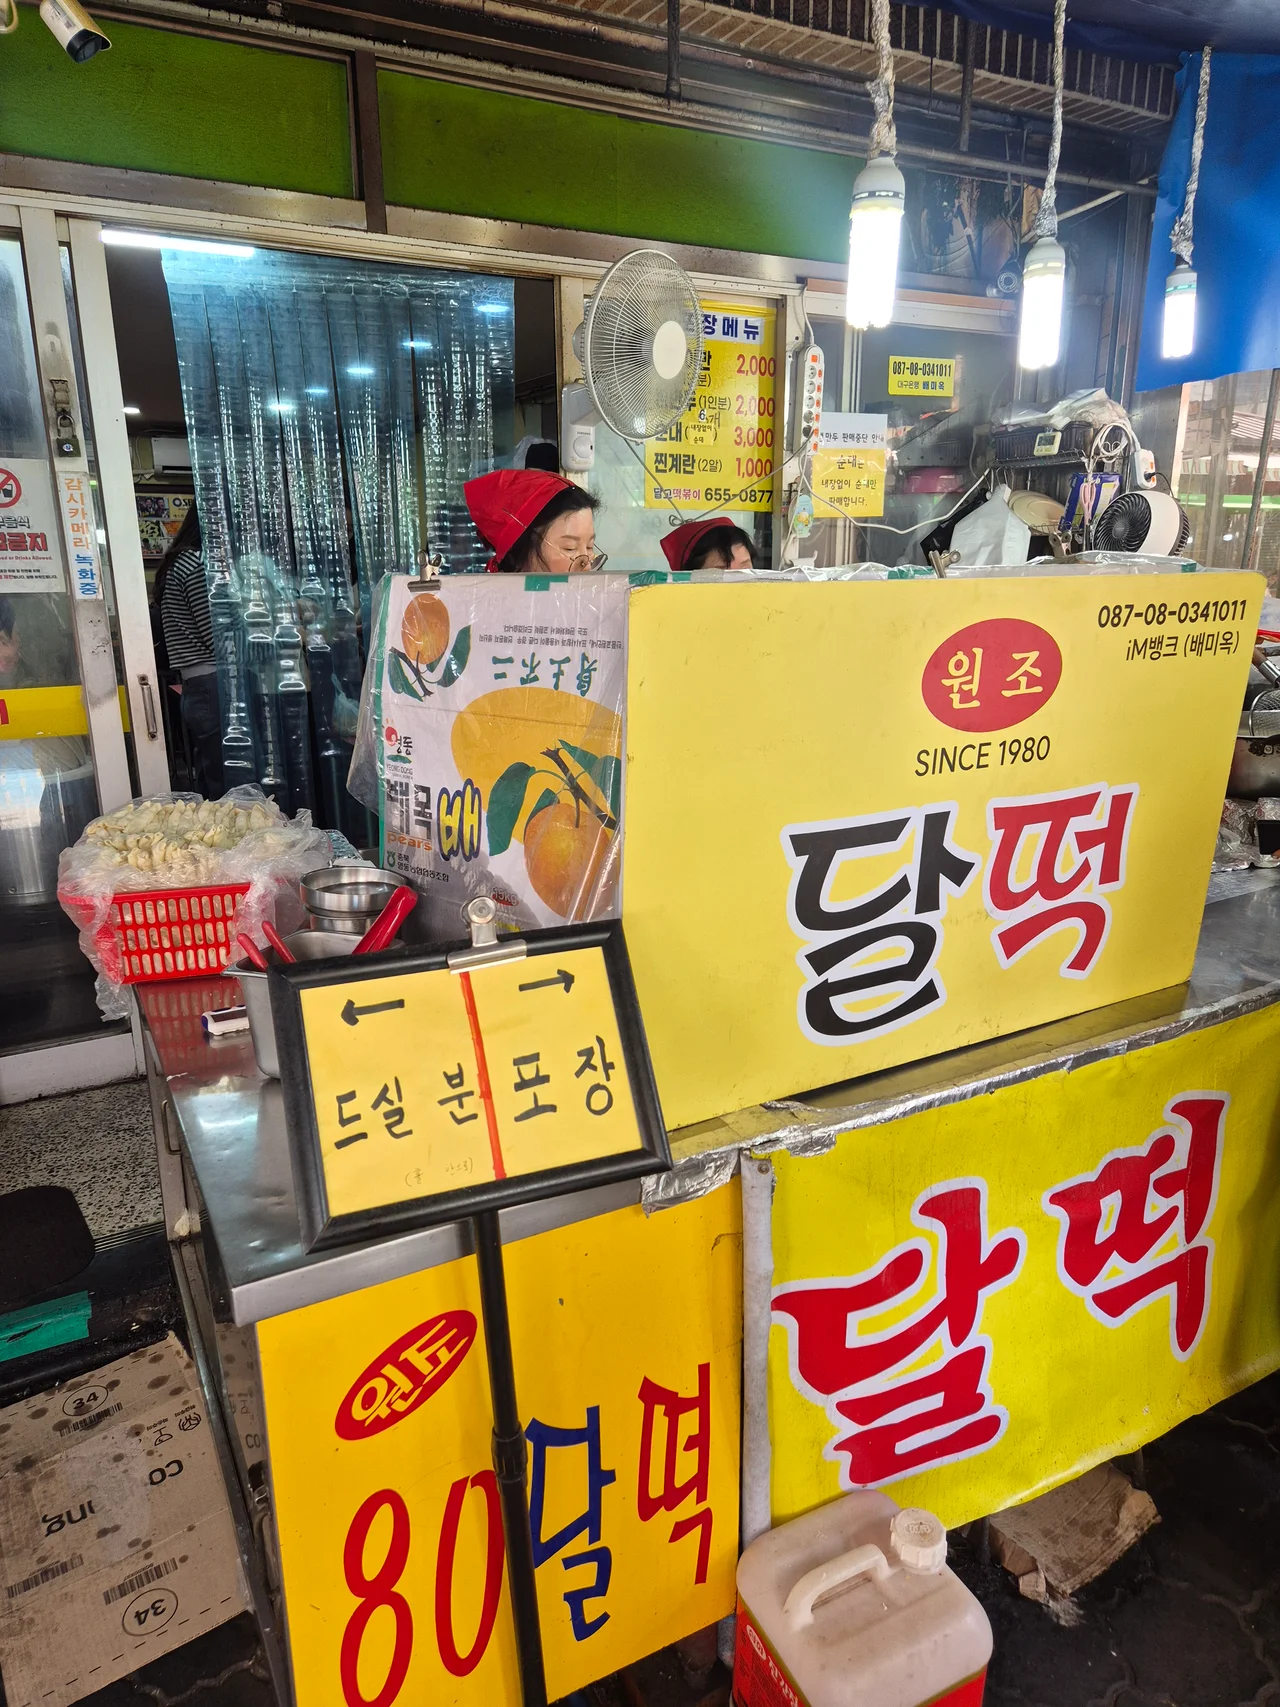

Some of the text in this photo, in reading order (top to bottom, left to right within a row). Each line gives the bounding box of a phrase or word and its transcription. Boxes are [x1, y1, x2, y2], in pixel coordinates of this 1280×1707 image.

[736, 353, 777, 378] 2,000
[892, 360, 952, 377] 087-08-0341011
[897, 380, 945, 391] 대구은행 배미옥
[698, 394, 731, 411] (1인분)
[735, 394, 776, 418] 2,000
[733, 425, 774, 449] 3,000
[842, 432, 869, 444] 판매중단
[653, 452, 773, 478] 찐계란 (2알) 1,000
[836, 455, 865, 470] 순대는
[704, 487, 774, 504] 655-0877
[821, 479, 851, 491] 내장없이
[74, 553, 98, 596] 녹화중
[1097, 599, 1247, 629] 087-08-0341011
[517, 635, 527, 644] 경우
[529, 636, 539, 645] 다른
[561, 638, 587, 647] 표시사항과
[1126, 631, 1240, 661] iM뱅크 (배미옥)
[491, 652, 598, 697] 身土不二
[941, 647, 1044, 710] 원조
[914, 735, 1051, 777] SINCE 1980
[437, 778, 482, 863] 배
[387, 831, 433, 851] pears
[788, 791, 1134, 1036] 달떡
[512, 1034, 616, 1123] 포장
[333, 1062, 479, 1150] 드실 분
[771, 1098, 1226, 1485] 달떡
[350, 1318, 470, 1427] 원조
[73, 1391, 99, 1411] 34
[340, 1362, 714, 1707] 80 달떡
[133, 1597, 167, 1627] 34
